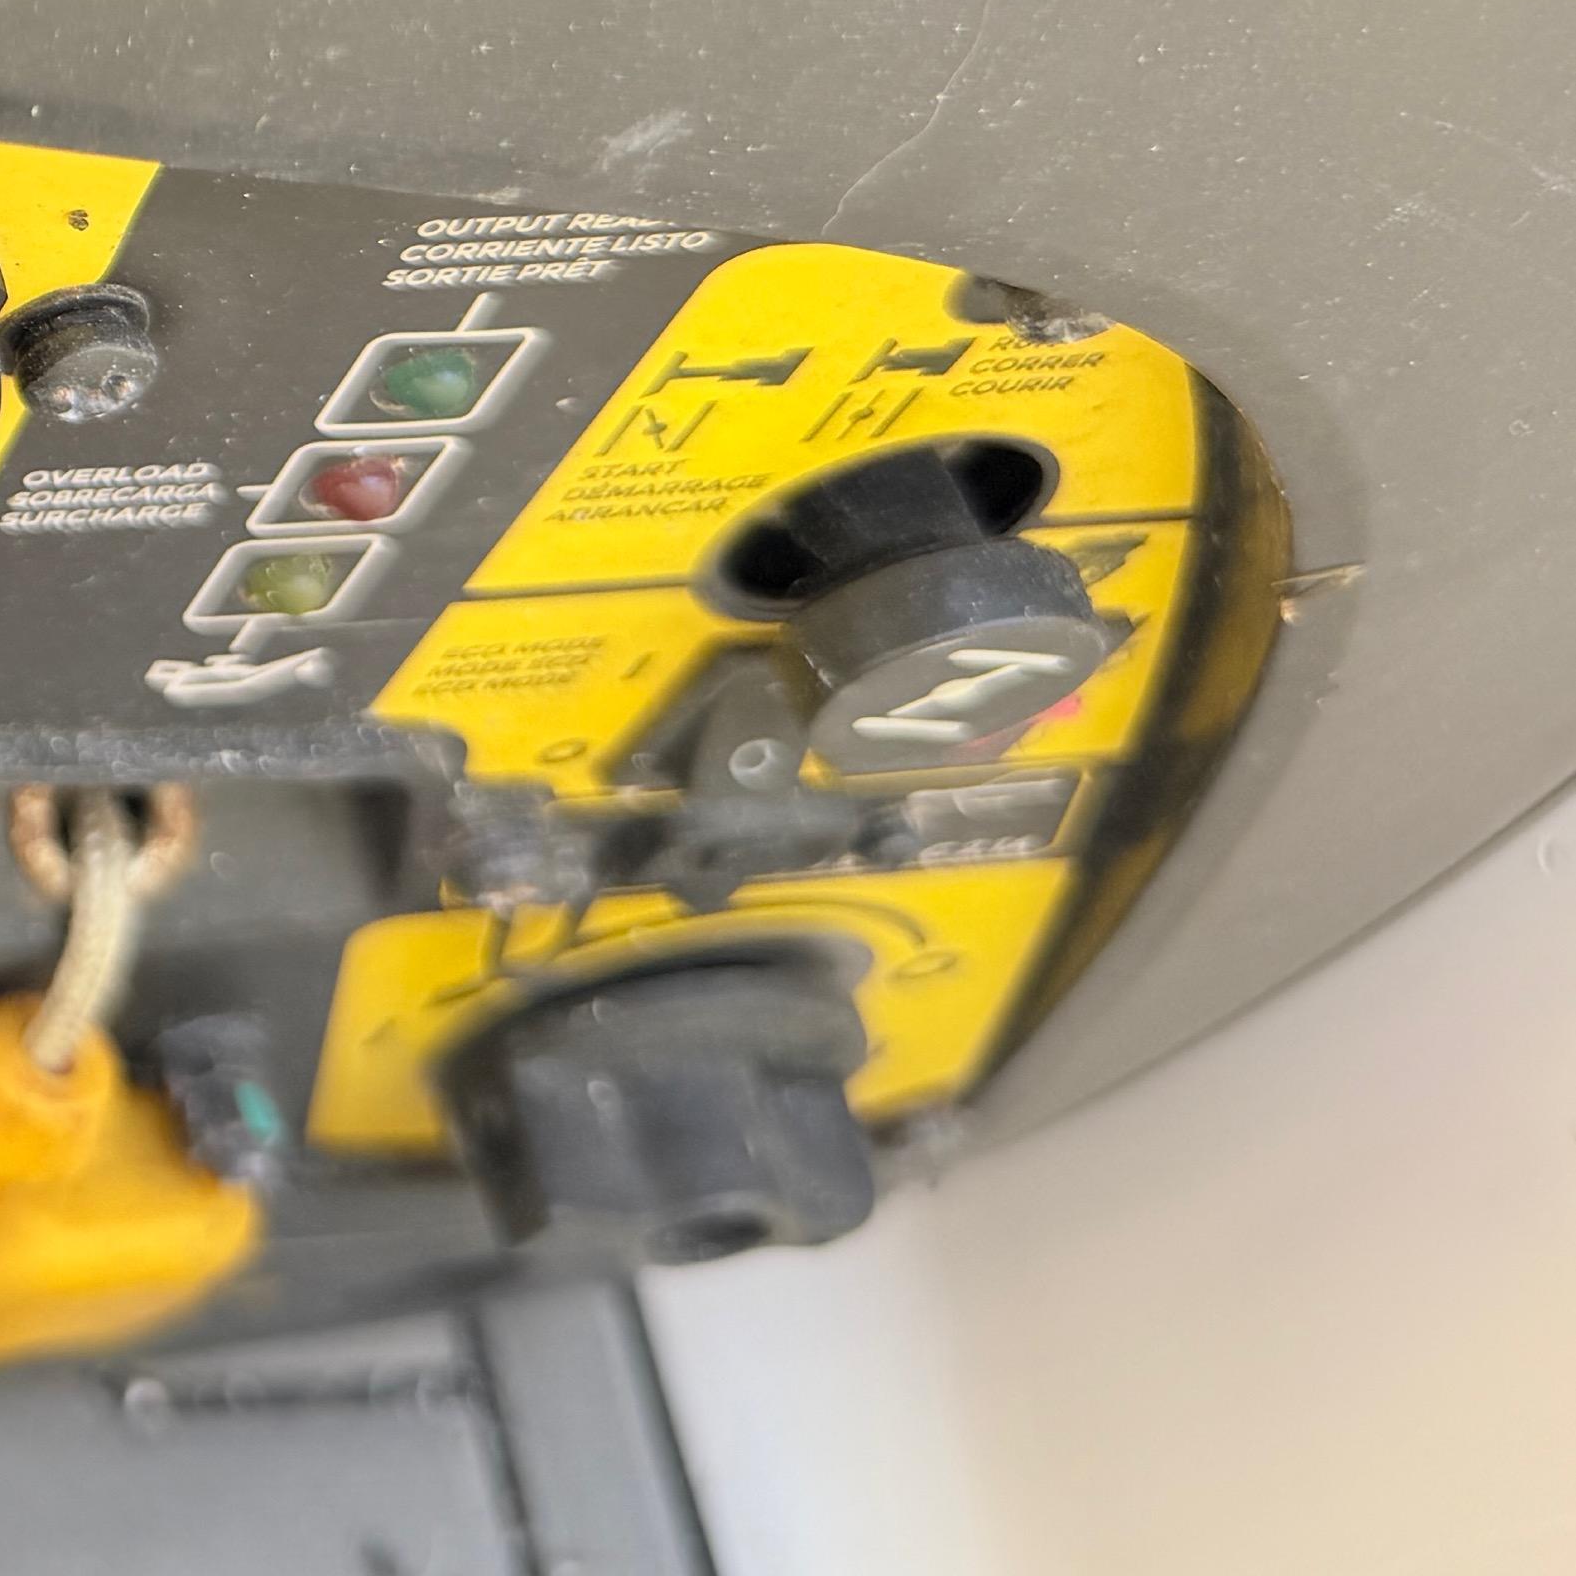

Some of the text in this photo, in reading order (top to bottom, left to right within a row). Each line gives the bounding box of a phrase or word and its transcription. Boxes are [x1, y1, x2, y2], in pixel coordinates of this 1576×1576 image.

[416, 211, 679, 239] OUTPUT REA
[399, 230, 714, 264] CORRIENTE LISTO
[381, 257, 616, 291] SORTIE PRÊT
[988, 335, 1056, 352] RU
[969, 351, 1107, 375] CORRER
[948, 375, 1076, 398] COURIR
[22, 462, 218, 490] OVERLOAD
[579, 458, 692, 480] START
[6, 482, 225, 511] SOBRECARGA
[561, 472, 771, 502] DÉMARRAGE
[0, 502, 215, 535] SURCHARGE
[543, 496, 729, 522] ARRANCAR
